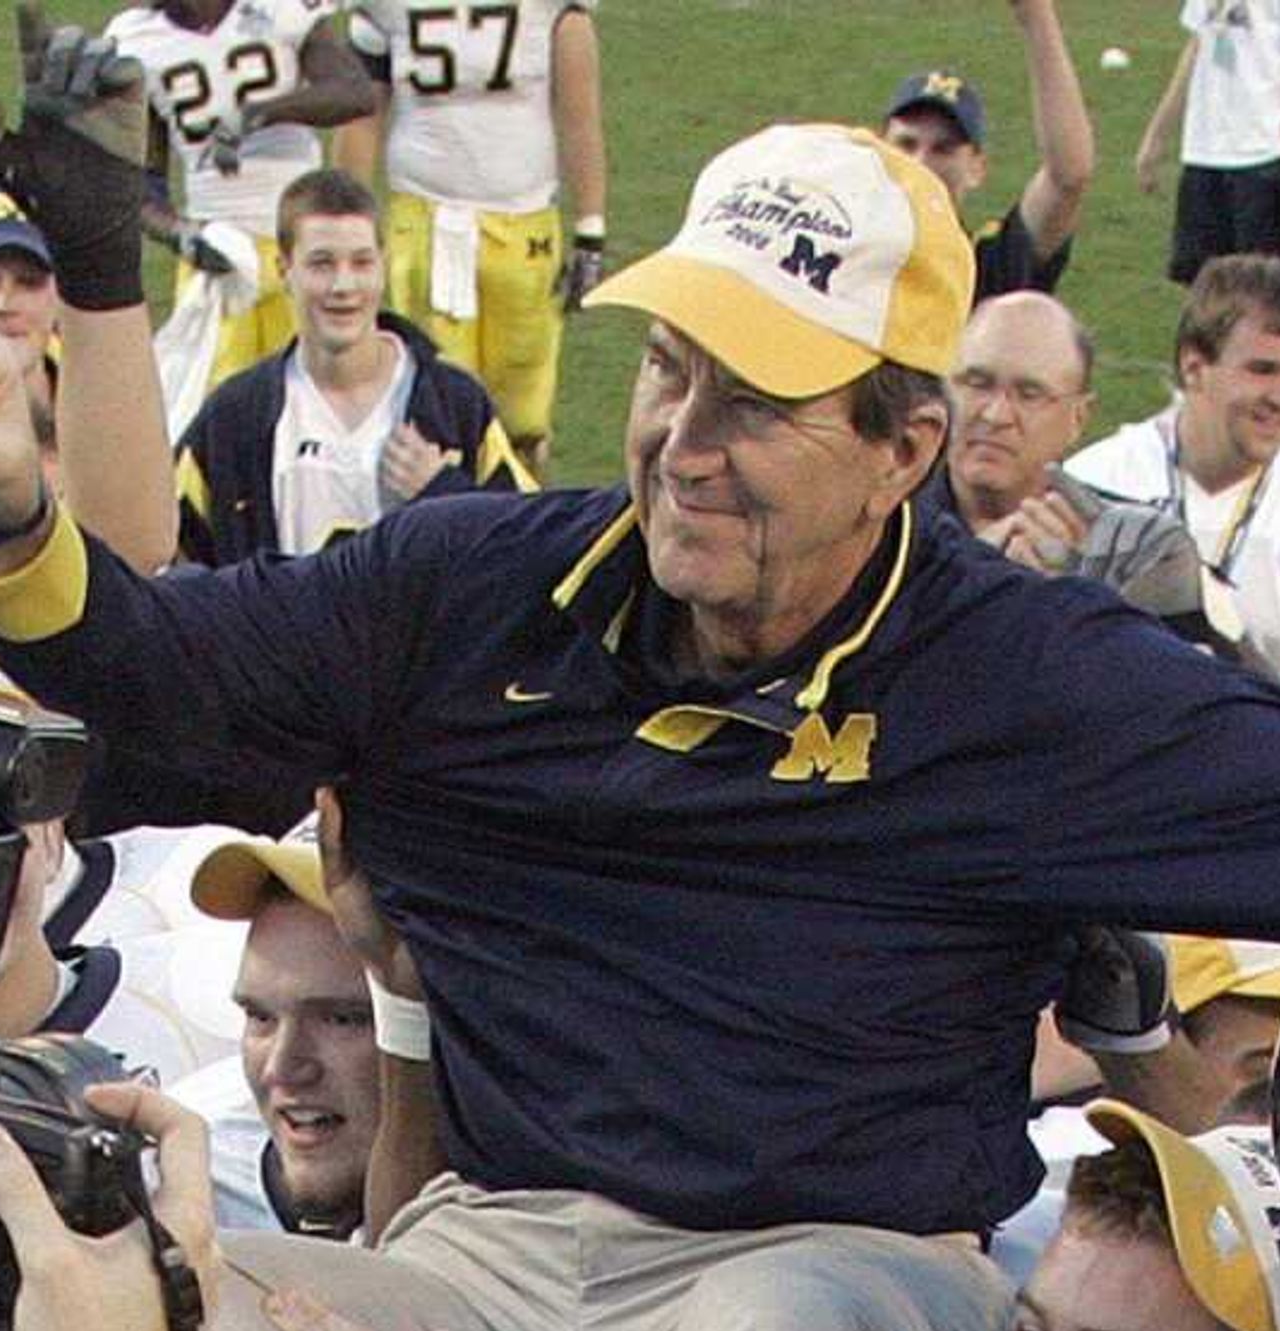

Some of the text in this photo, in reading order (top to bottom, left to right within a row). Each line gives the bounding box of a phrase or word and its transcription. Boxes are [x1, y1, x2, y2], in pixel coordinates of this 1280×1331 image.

[408, 3, 519, 94] 57
[163, 41, 277, 143] 22
[779, 232, 842, 296] M
[770, 712, 877, 783] M
